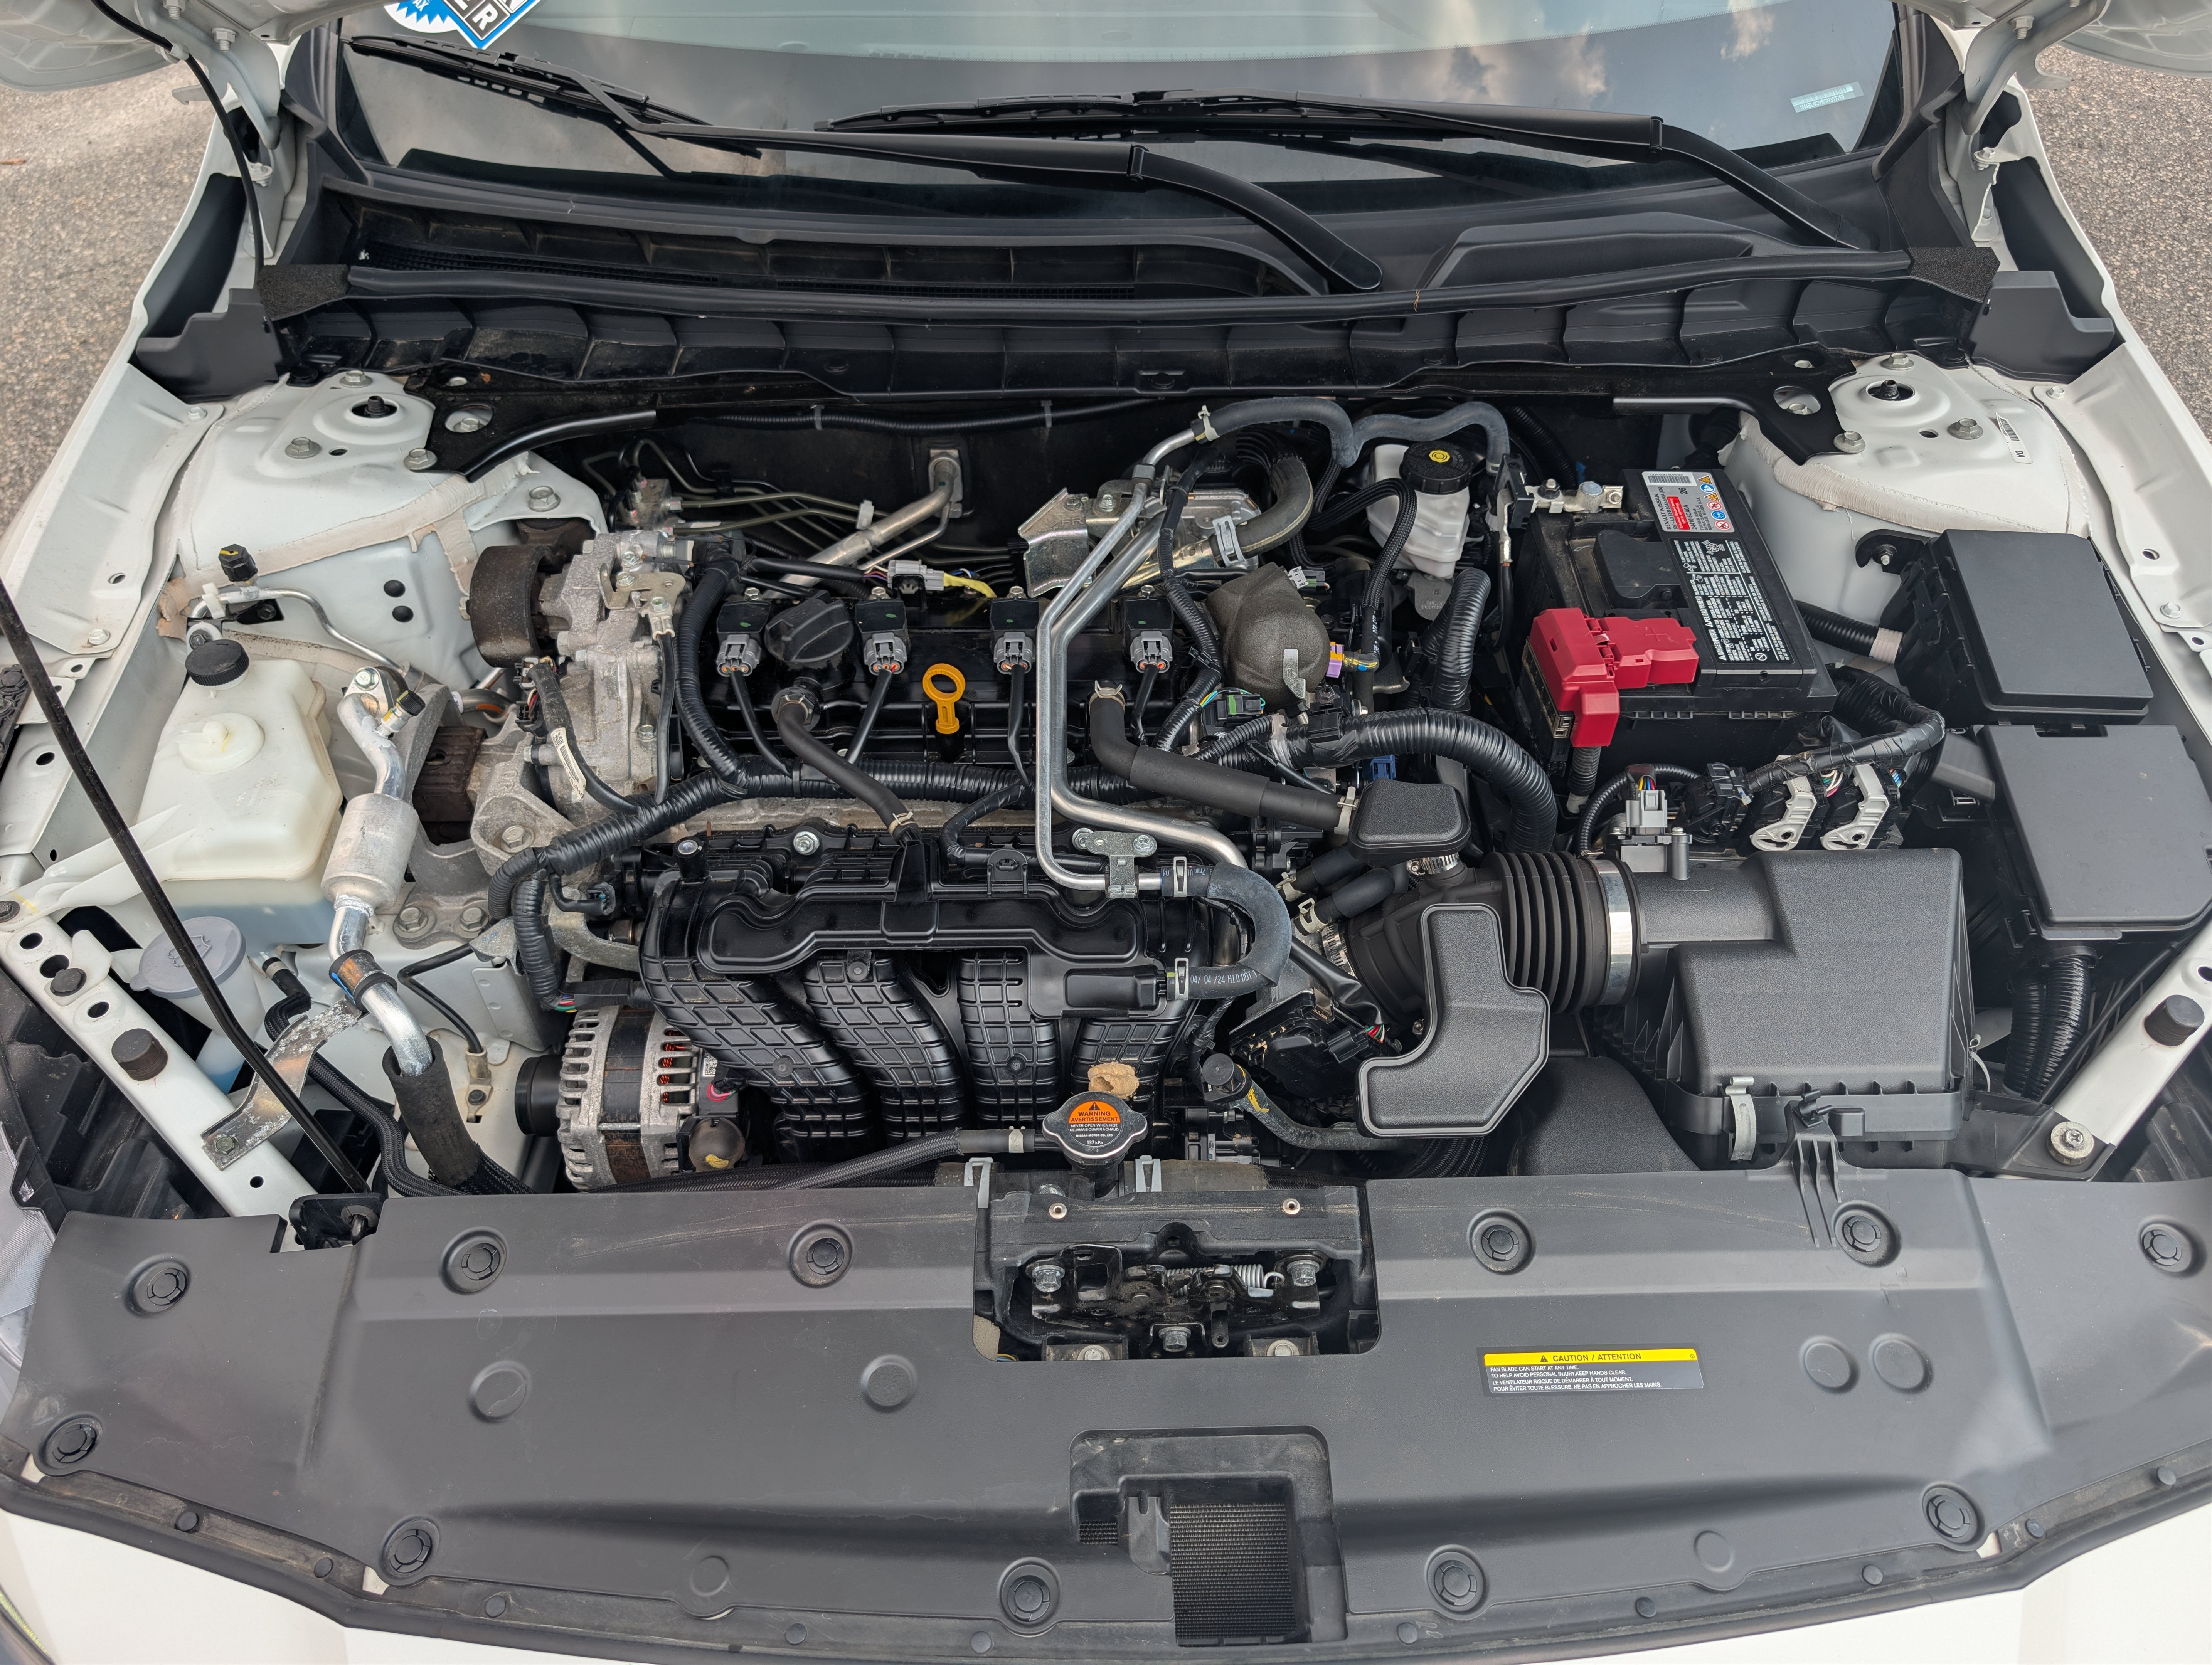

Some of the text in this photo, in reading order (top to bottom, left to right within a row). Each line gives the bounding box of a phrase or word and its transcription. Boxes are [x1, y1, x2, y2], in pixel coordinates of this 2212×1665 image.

[2015, 450, 2025, 459] DA
[1654, 494, 1671, 530] RENAULT NISSAN
[1683, 505, 1697, 530] 24410 6CA0A
[1695, 596, 1710, 622] PELIGRO/VENENO
[1709, 629, 1724, 655] DANGER/POISON
